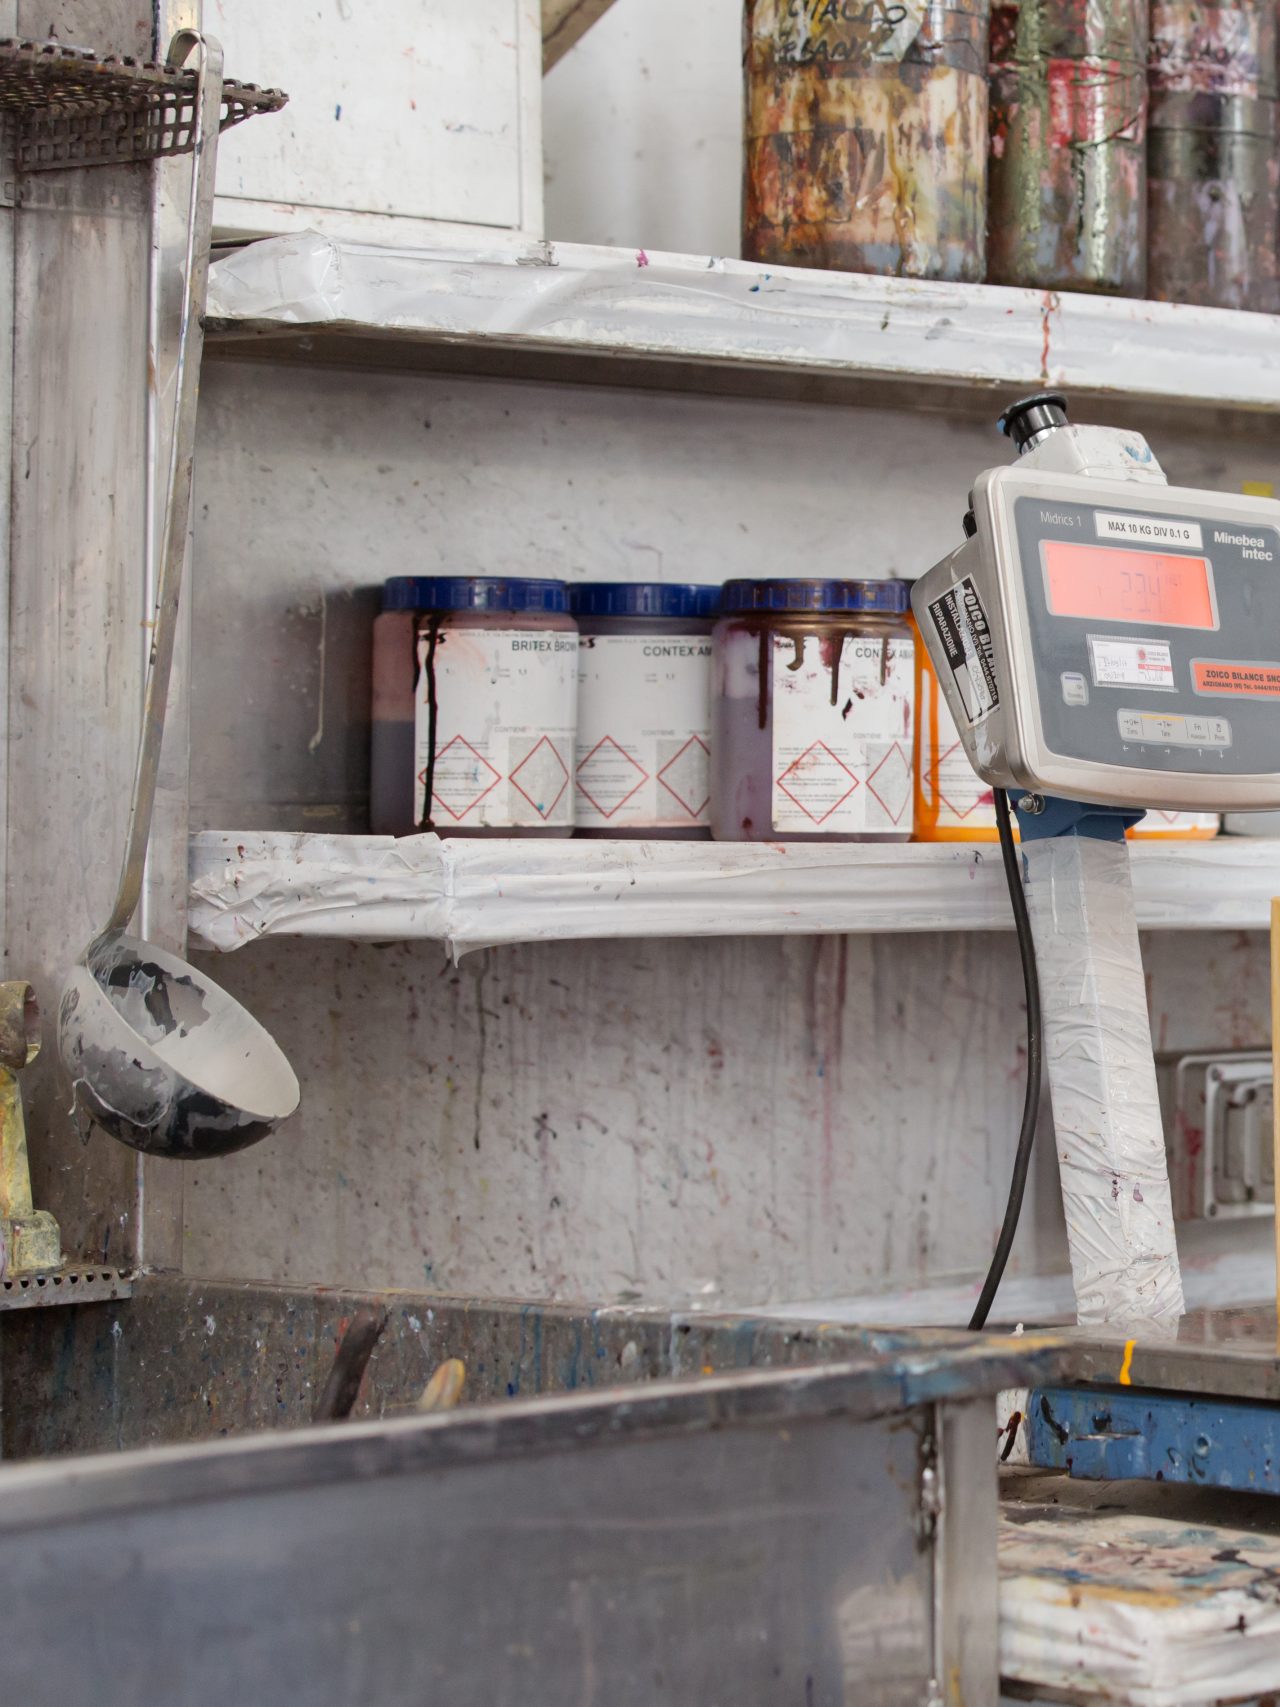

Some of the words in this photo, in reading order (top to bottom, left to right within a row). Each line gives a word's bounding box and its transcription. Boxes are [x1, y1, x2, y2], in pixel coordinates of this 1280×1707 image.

[1040, 511, 1074, 527] Midrics
[1077, 515, 1082, 527] 1
[1108, 521, 1126, 533] MAX
[1128, 522, 1138, 534] 10
[1140, 524, 1152, 536] KG
[1154, 525, 1168, 537] DIV
[1169, 527, 1182, 539] 0.1
[1183, 529, 1190, 539] G
[1214, 531, 1265, 548] Minebea
[1242, 548, 1273, 561] intec
[963, 586, 986, 631] ZOICO
[932, 602, 958, 658] RIPARAZIONE
[944, 593, 973, 658] INSTALLAZIONE
[511, 640, 552, 651] BRITEX
[643, 646, 694, 657] CONTEX
[855, 647, 896, 658] CONEX
[1206, 670, 1229, 679] ZOICO
[1232, 671, 1264, 682] BILANCE
